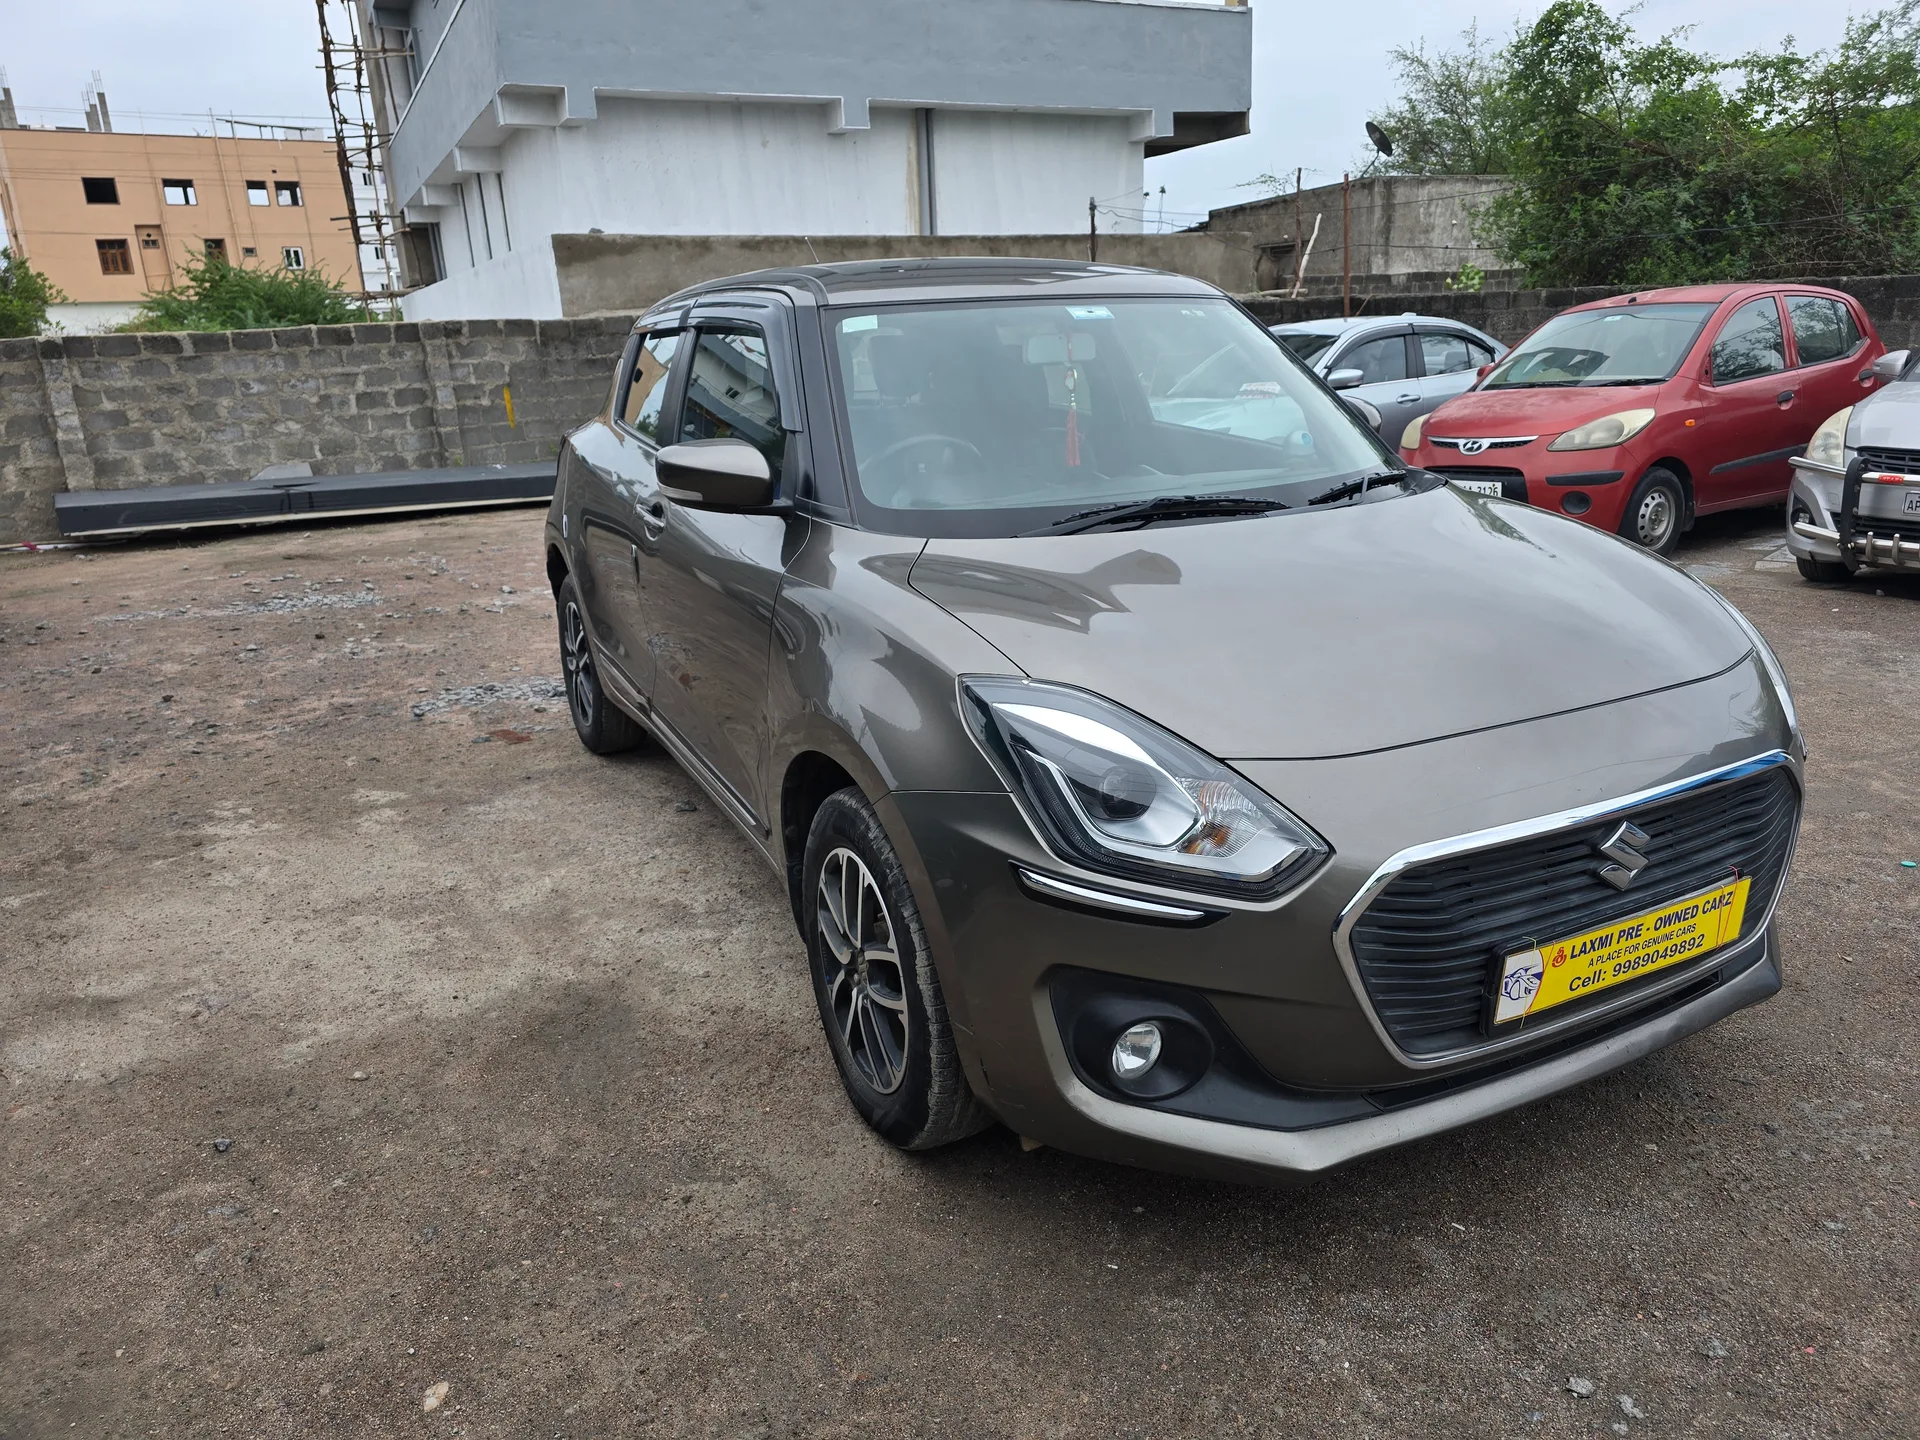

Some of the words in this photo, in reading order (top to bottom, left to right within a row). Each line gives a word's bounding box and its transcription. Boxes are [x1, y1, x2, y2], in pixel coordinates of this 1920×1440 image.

[1570, 932, 1614, 959] LAXMI
[1616, 922, 1645, 944] PRE
[1653, 904, 1699, 931] OWNED
[1701, 890, 1734, 915] CARZ
[1588, 958, 1594, 968] A
[1596, 948, 1623, 965] PLACE
[1623, 942, 1640, 957] FOR
[1641, 930, 1675, 950] GENUINE
[1675, 923, 1697, 938] CARS
[1569, 969, 1607, 992] Cell:
[1612, 933, 1705, 978] 9989049892
